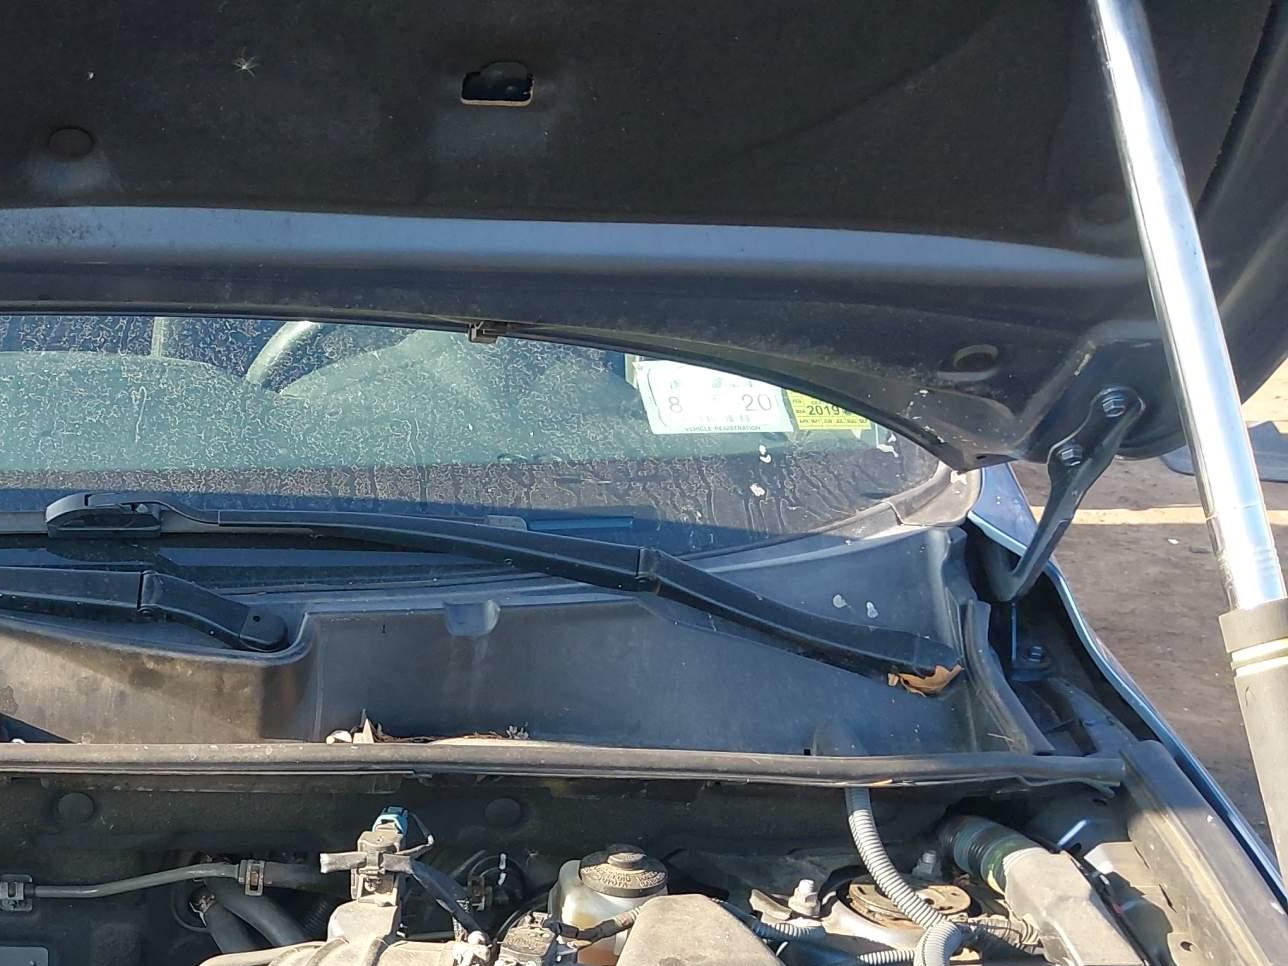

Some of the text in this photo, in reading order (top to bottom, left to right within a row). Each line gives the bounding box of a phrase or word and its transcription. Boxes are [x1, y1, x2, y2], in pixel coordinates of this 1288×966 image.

[667, 396, 684, 414] 8
[742, 394, 772, 412] 20
[806, 405, 840, 416] 2019
